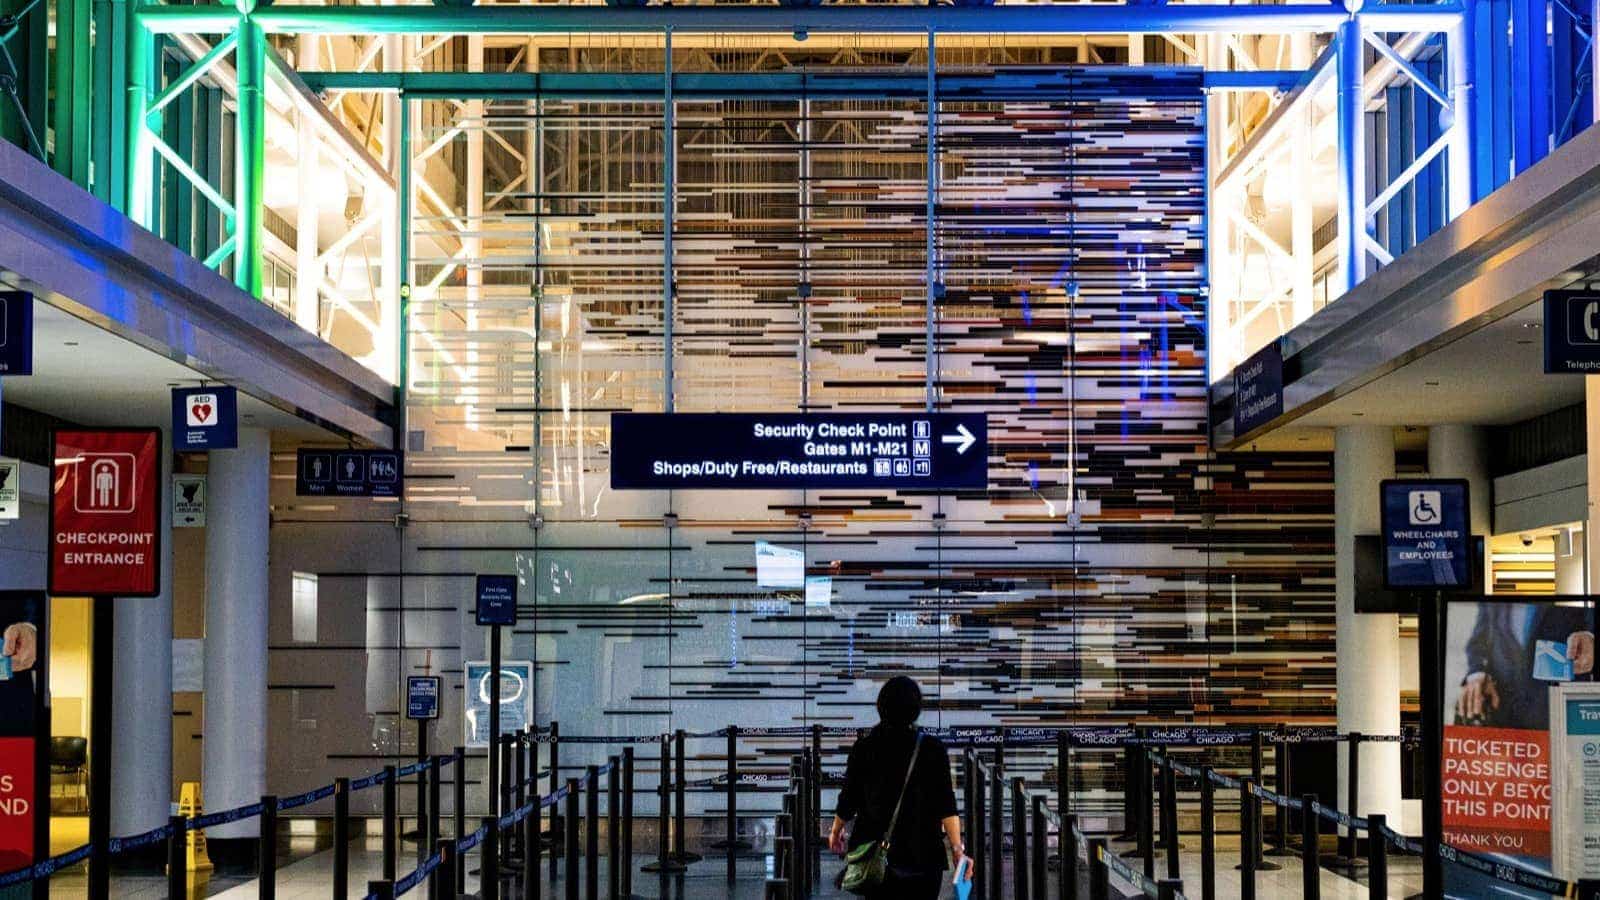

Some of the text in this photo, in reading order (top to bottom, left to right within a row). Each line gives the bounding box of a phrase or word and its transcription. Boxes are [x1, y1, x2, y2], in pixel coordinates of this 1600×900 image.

[754, 423, 907, 440] Security Check Point
[804, 442, 847, 456] Gates
[851, 442, 907, 456] M1-M21
[653, 461, 868, 478] Shops/Duty Free/Restaurants
[56, 532, 154, 544] CHECKPOINT
[1393, 530, 1459, 538] WHEELCHAIRS
[1417, 541, 1436, 549] AND
[64, 553, 145, 565] ENTRANCE
[1400, 551, 1454, 560] EMPLOYEES
[956, 729, 982, 737] CHICAGO
[1010, 727, 1044, 736] CHICAGO
[1152, 730, 1187, 739] CHICAGO
[520, 735, 557, 744] CHICAGO
[974, 735, 1004, 743] CHICAGO
[1079, 734, 1116, 744] CHICAGO
[1196, 735, 1234, 744] CHICAGO
[1269, 735, 1301, 743] CHICAGO
[1445, 738, 1541, 758] TICKETED
[1445, 759, 1548, 779] PASSENGE
[742, 774, 768, 782] CHICAGO
[1445, 779, 1498, 796] ONLY
[1443, 799, 1552, 820] THIS POINT
[1442, 832, 1524, 848] THANK YOU
